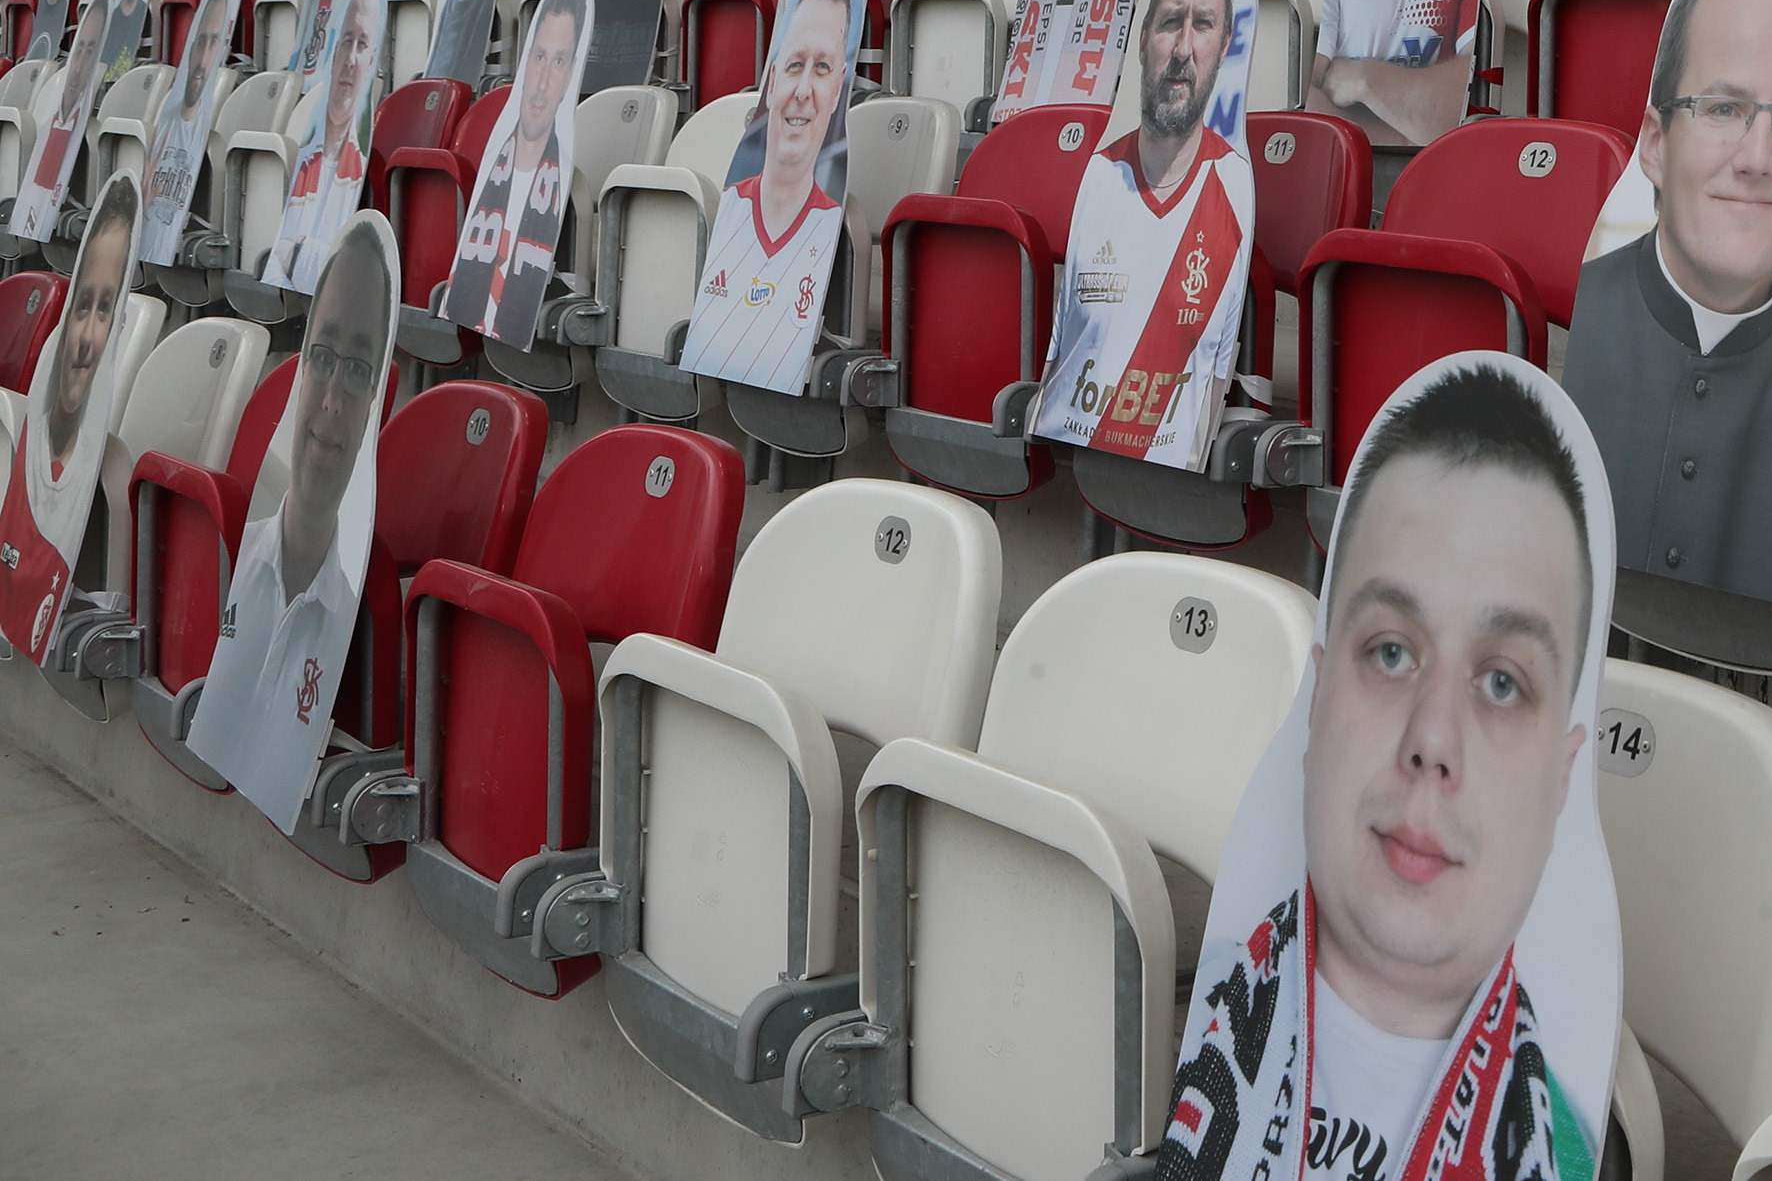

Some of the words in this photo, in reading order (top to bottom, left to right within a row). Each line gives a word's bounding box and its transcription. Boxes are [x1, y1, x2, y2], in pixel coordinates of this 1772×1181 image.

[628, 105, 633, 117] 7
[896, 120, 902, 133] 9
[1067, 129, 1078, 144] 10
[1273, 139, 1289, 156] 11
[1527, 149, 1548, 169] 12
[704, 285, 729, 298] adidas
[751, 287, 770, 301] LOTTO
[1176, 308, 1198, 325] 110
[1070, 359, 1193, 425] forBET
[474, 417, 487, 436] 10
[654, 465, 670, 487] 11
[884, 527, 904, 555] 12
[1183, 607, 1208, 638] 13
[1607, 722, 1642, 759] 14
